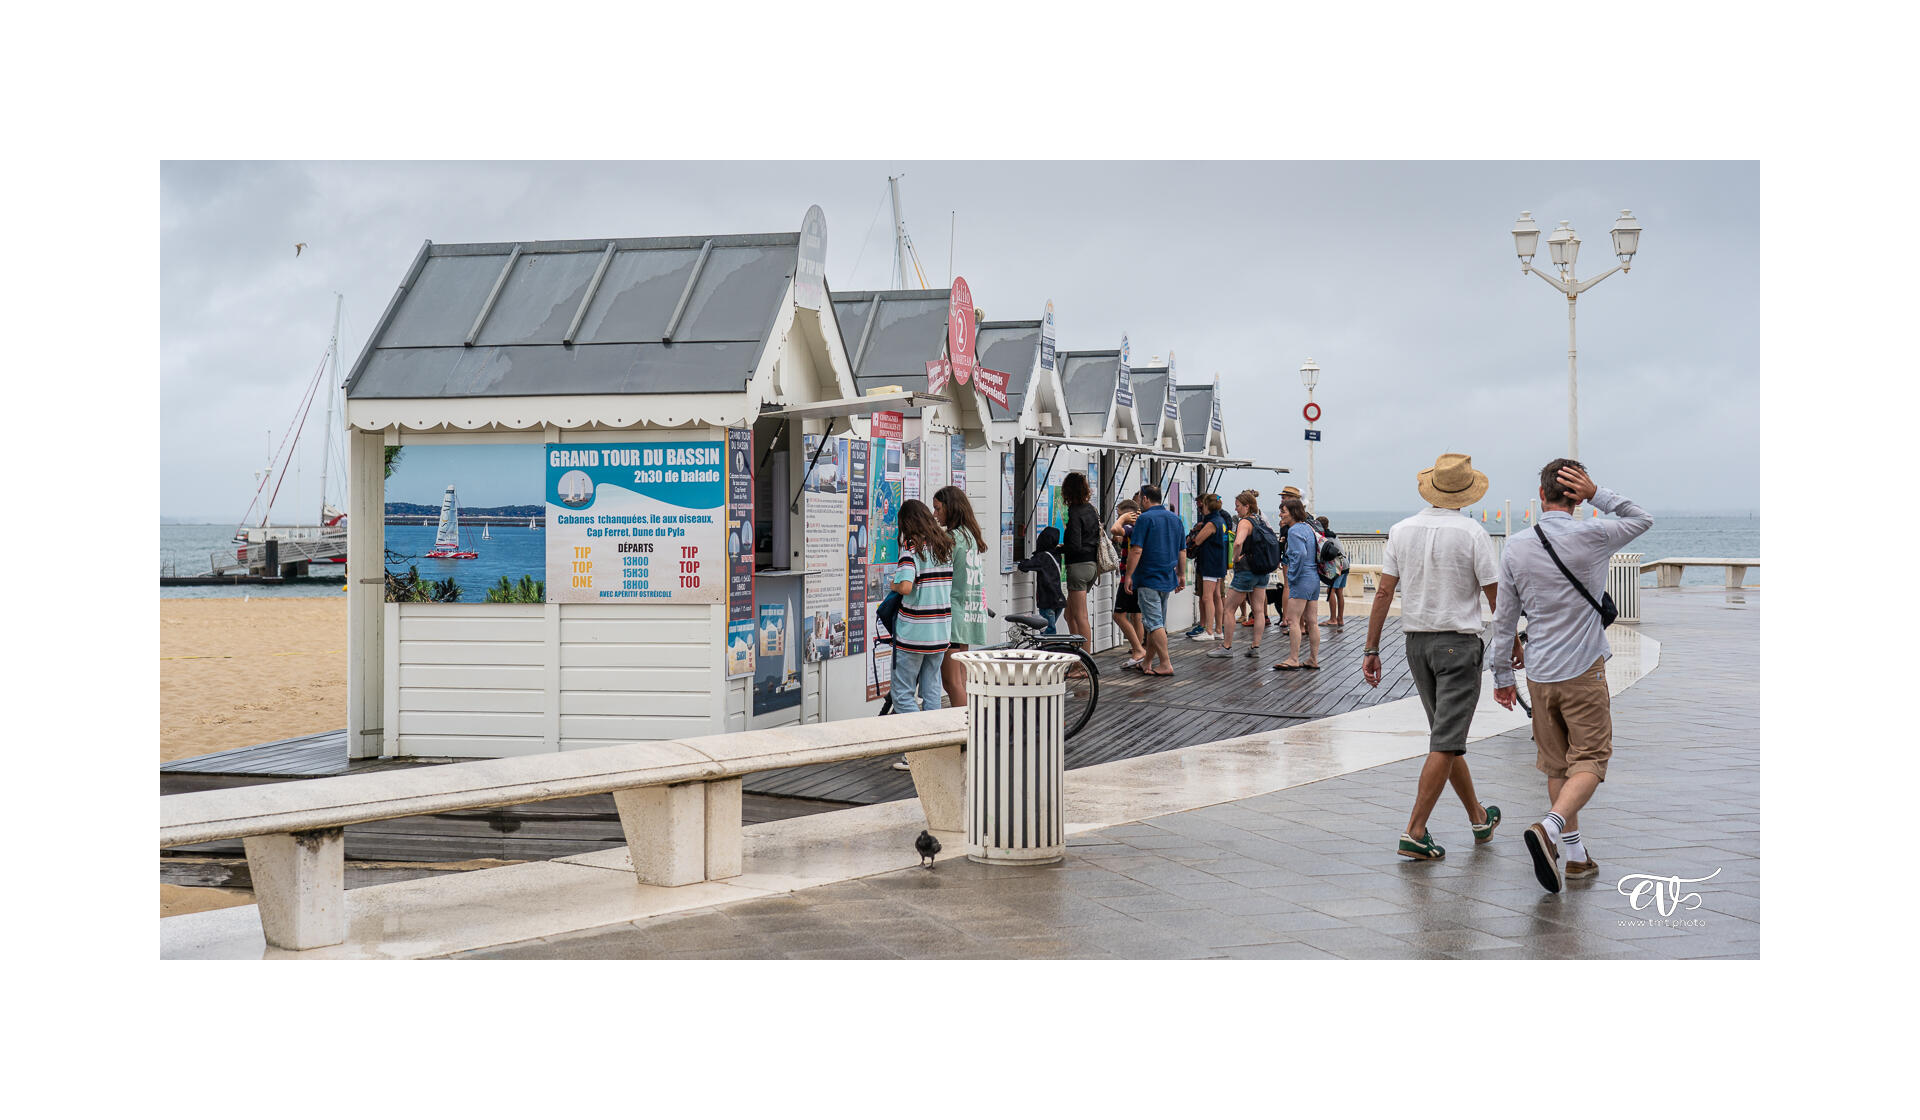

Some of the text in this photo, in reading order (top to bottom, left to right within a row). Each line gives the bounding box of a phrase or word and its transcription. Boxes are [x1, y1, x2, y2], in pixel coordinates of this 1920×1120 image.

[958, 316, 964, 344] 2
[550, 448, 720, 467] GRAND TOUR DU BASSIN
[634, 470, 720, 483] 2h30 de balade
[558, 514, 595, 525] Cabanes
[598, 514, 649, 525] tchanquées,
[662, 515, 677, 524] aux
[678, 514, 714, 524] oiseaux,
[587, 527, 685, 538] Cap Ferret, Dune du Pyla
[573, 546, 592, 559] TIP
[618, 542, 654, 553] DÉPARTS
[681, 546, 698, 559] TIP
[572, 561, 593, 573] TOP
[622, 556, 649, 566] 13H00
[679, 561, 700, 573] TOP
[622, 568, 649, 578] 15H30
[572, 576, 593, 588] ONE
[622, 580, 649, 590] 18H00
[679, 576, 700, 588] TOO
